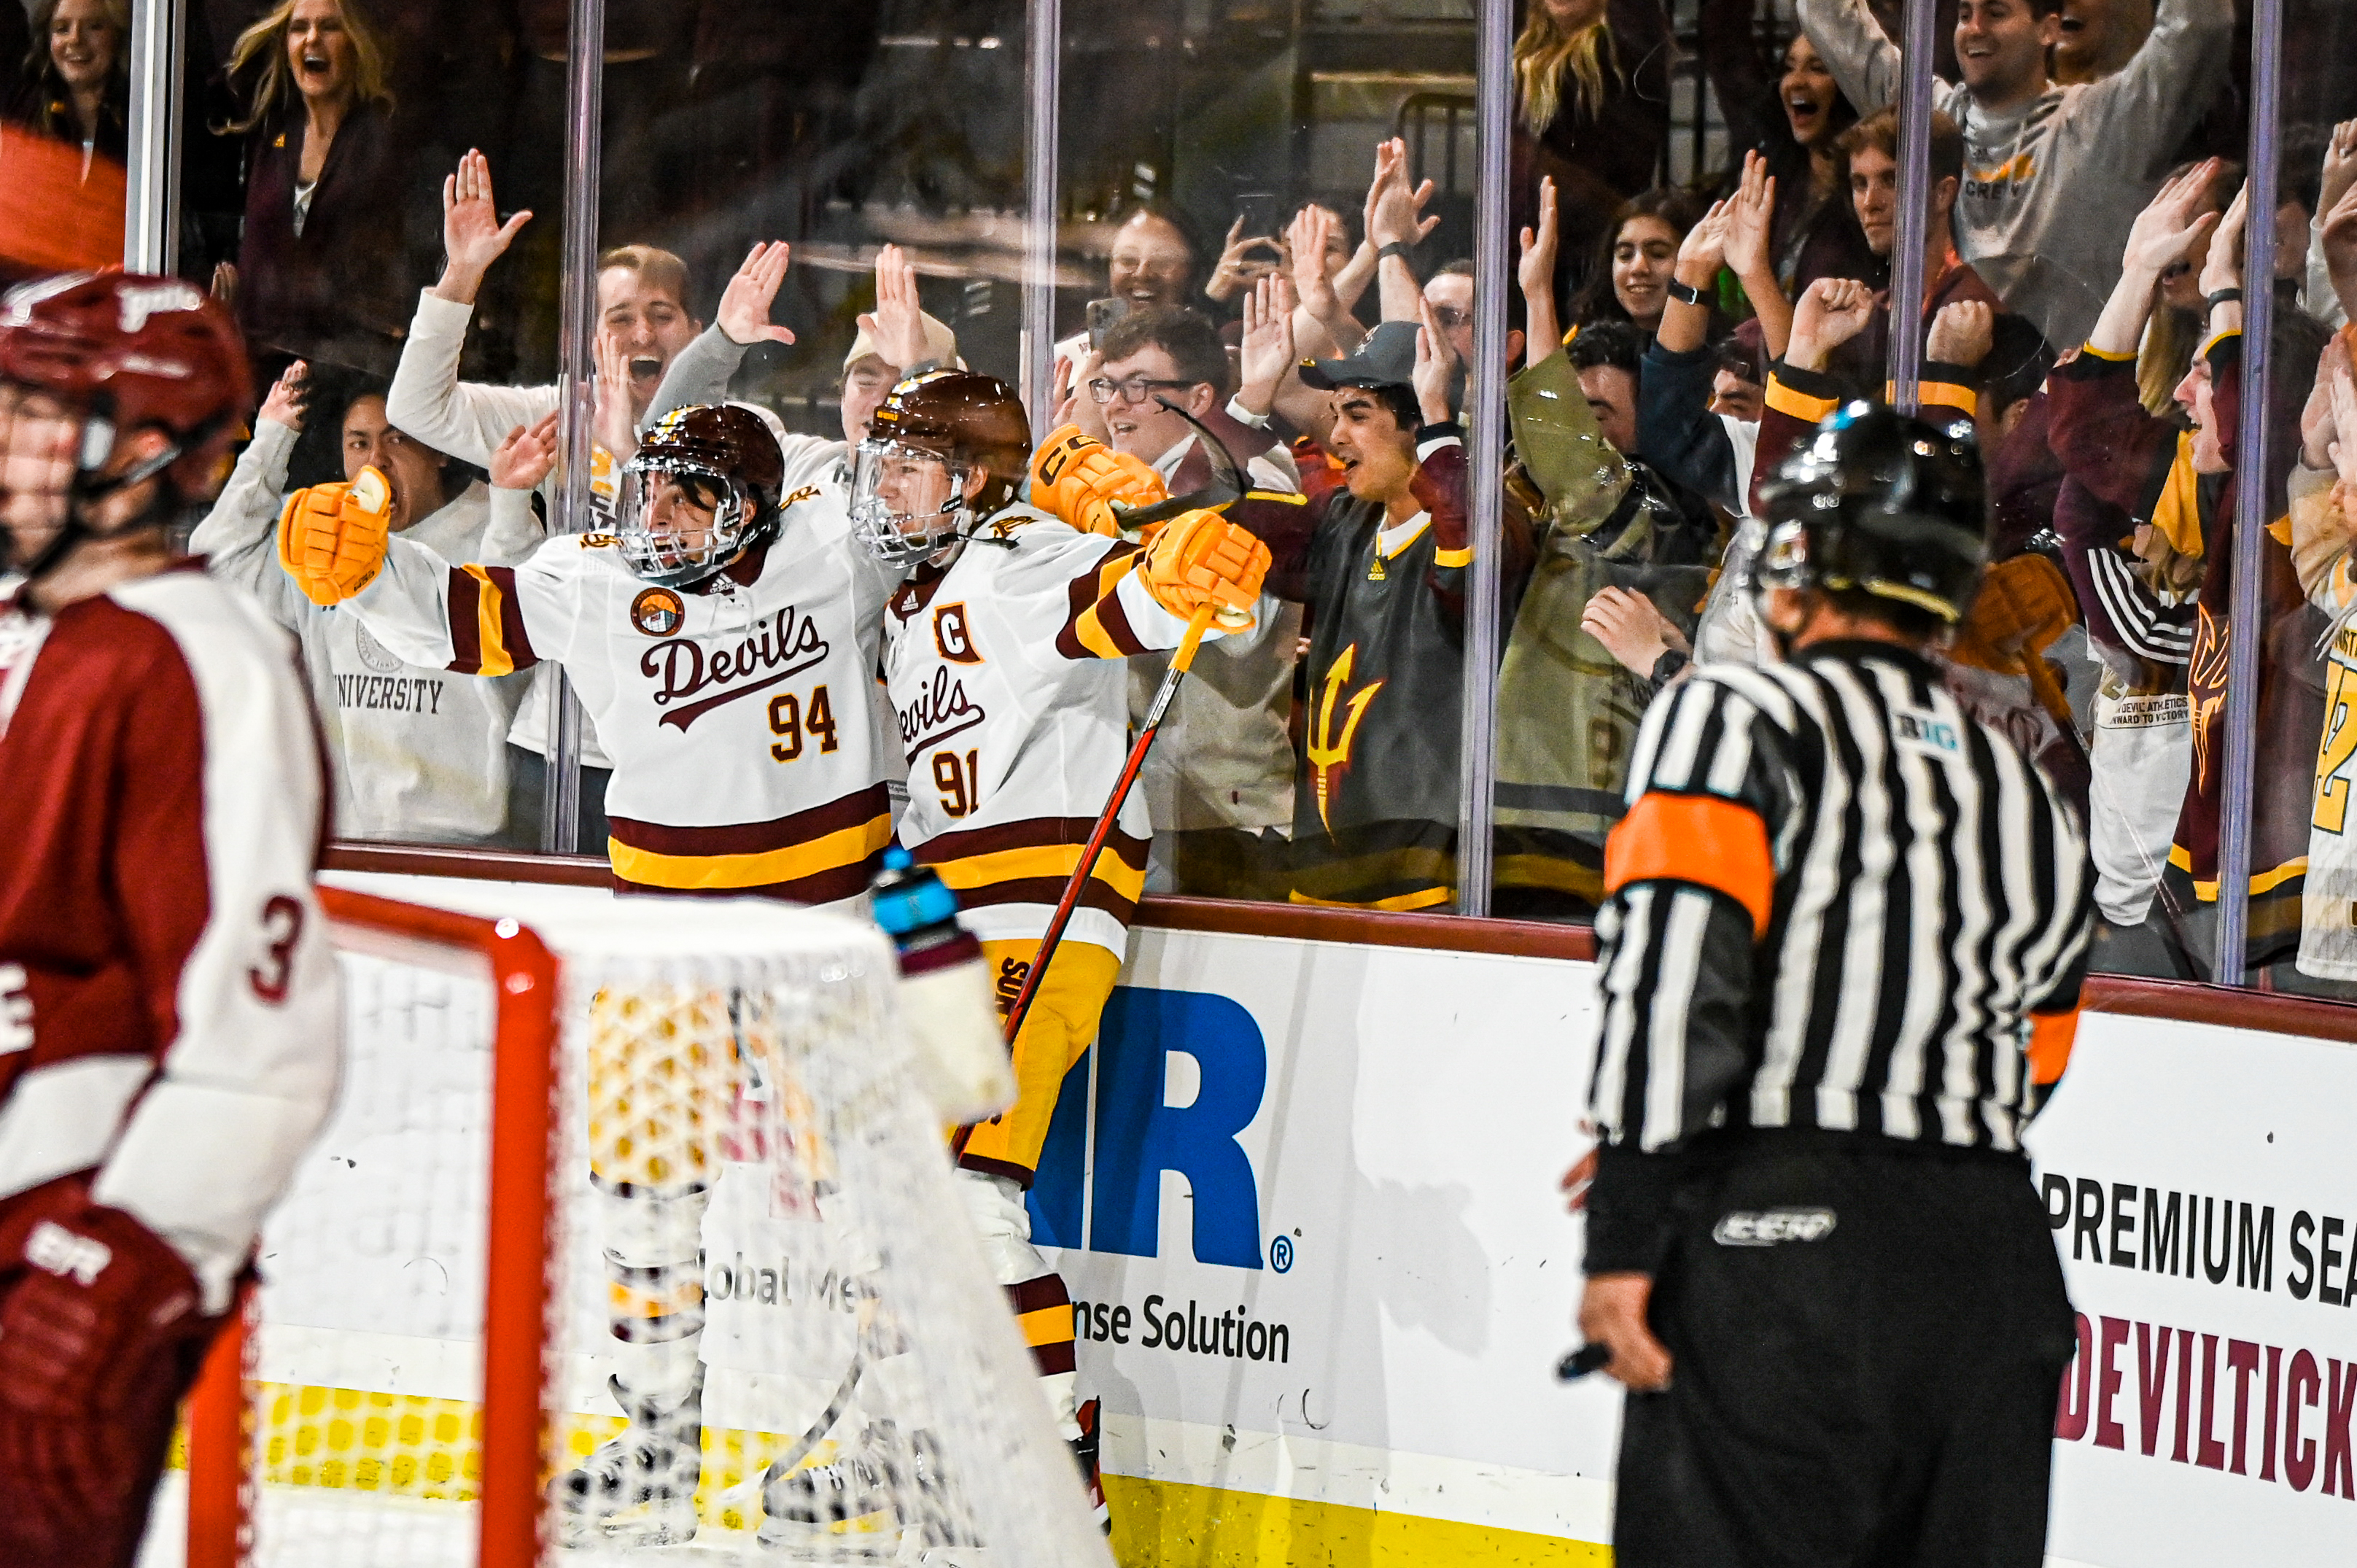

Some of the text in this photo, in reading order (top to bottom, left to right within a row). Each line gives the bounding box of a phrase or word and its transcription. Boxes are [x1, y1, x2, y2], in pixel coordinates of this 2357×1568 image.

[640, 605, 829, 707] Devils
[940, 613, 966, 654] C
[335, 674, 443, 714] NIVERSITY
[767, 684, 839, 764] 94
[2144, 713, 2154, 723] TO
[932, 748, 979, 819] 91
[249, 895, 303, 1004] 3
[2042, 1173, 2275, 1292] PREMIUM
[1071, 1300, 1131, 1344] nse
[1141, 1294, 1289, 1363] Solution
